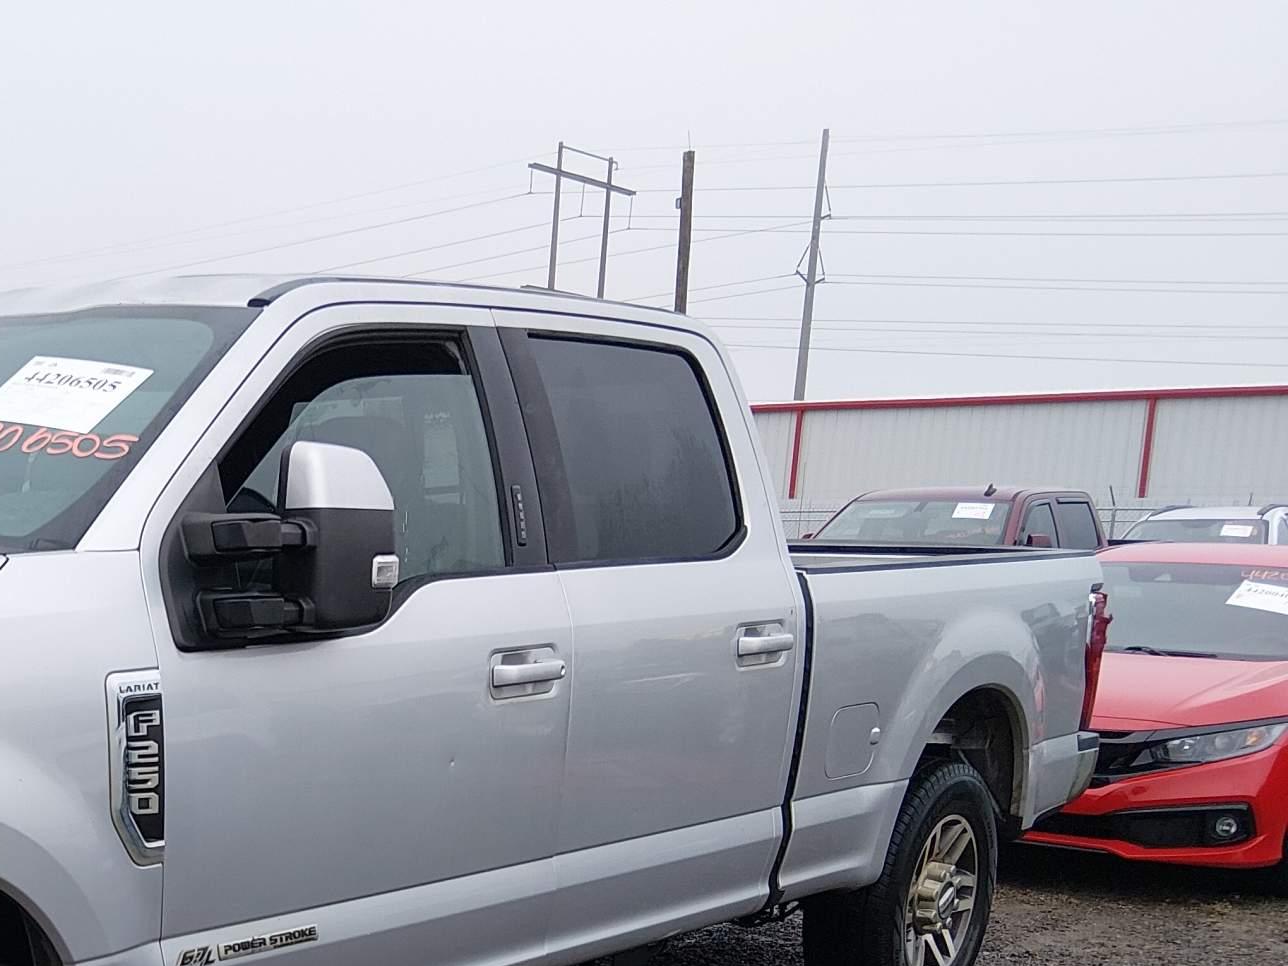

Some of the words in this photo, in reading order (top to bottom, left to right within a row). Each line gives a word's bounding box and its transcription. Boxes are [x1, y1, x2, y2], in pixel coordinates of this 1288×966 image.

[23, 371, 123, 393] 44206505
[119, 682, 160, 694] LARIAT
[223, 937, 267, 956] POWER
[269, 926, 317, 945] STROKE
